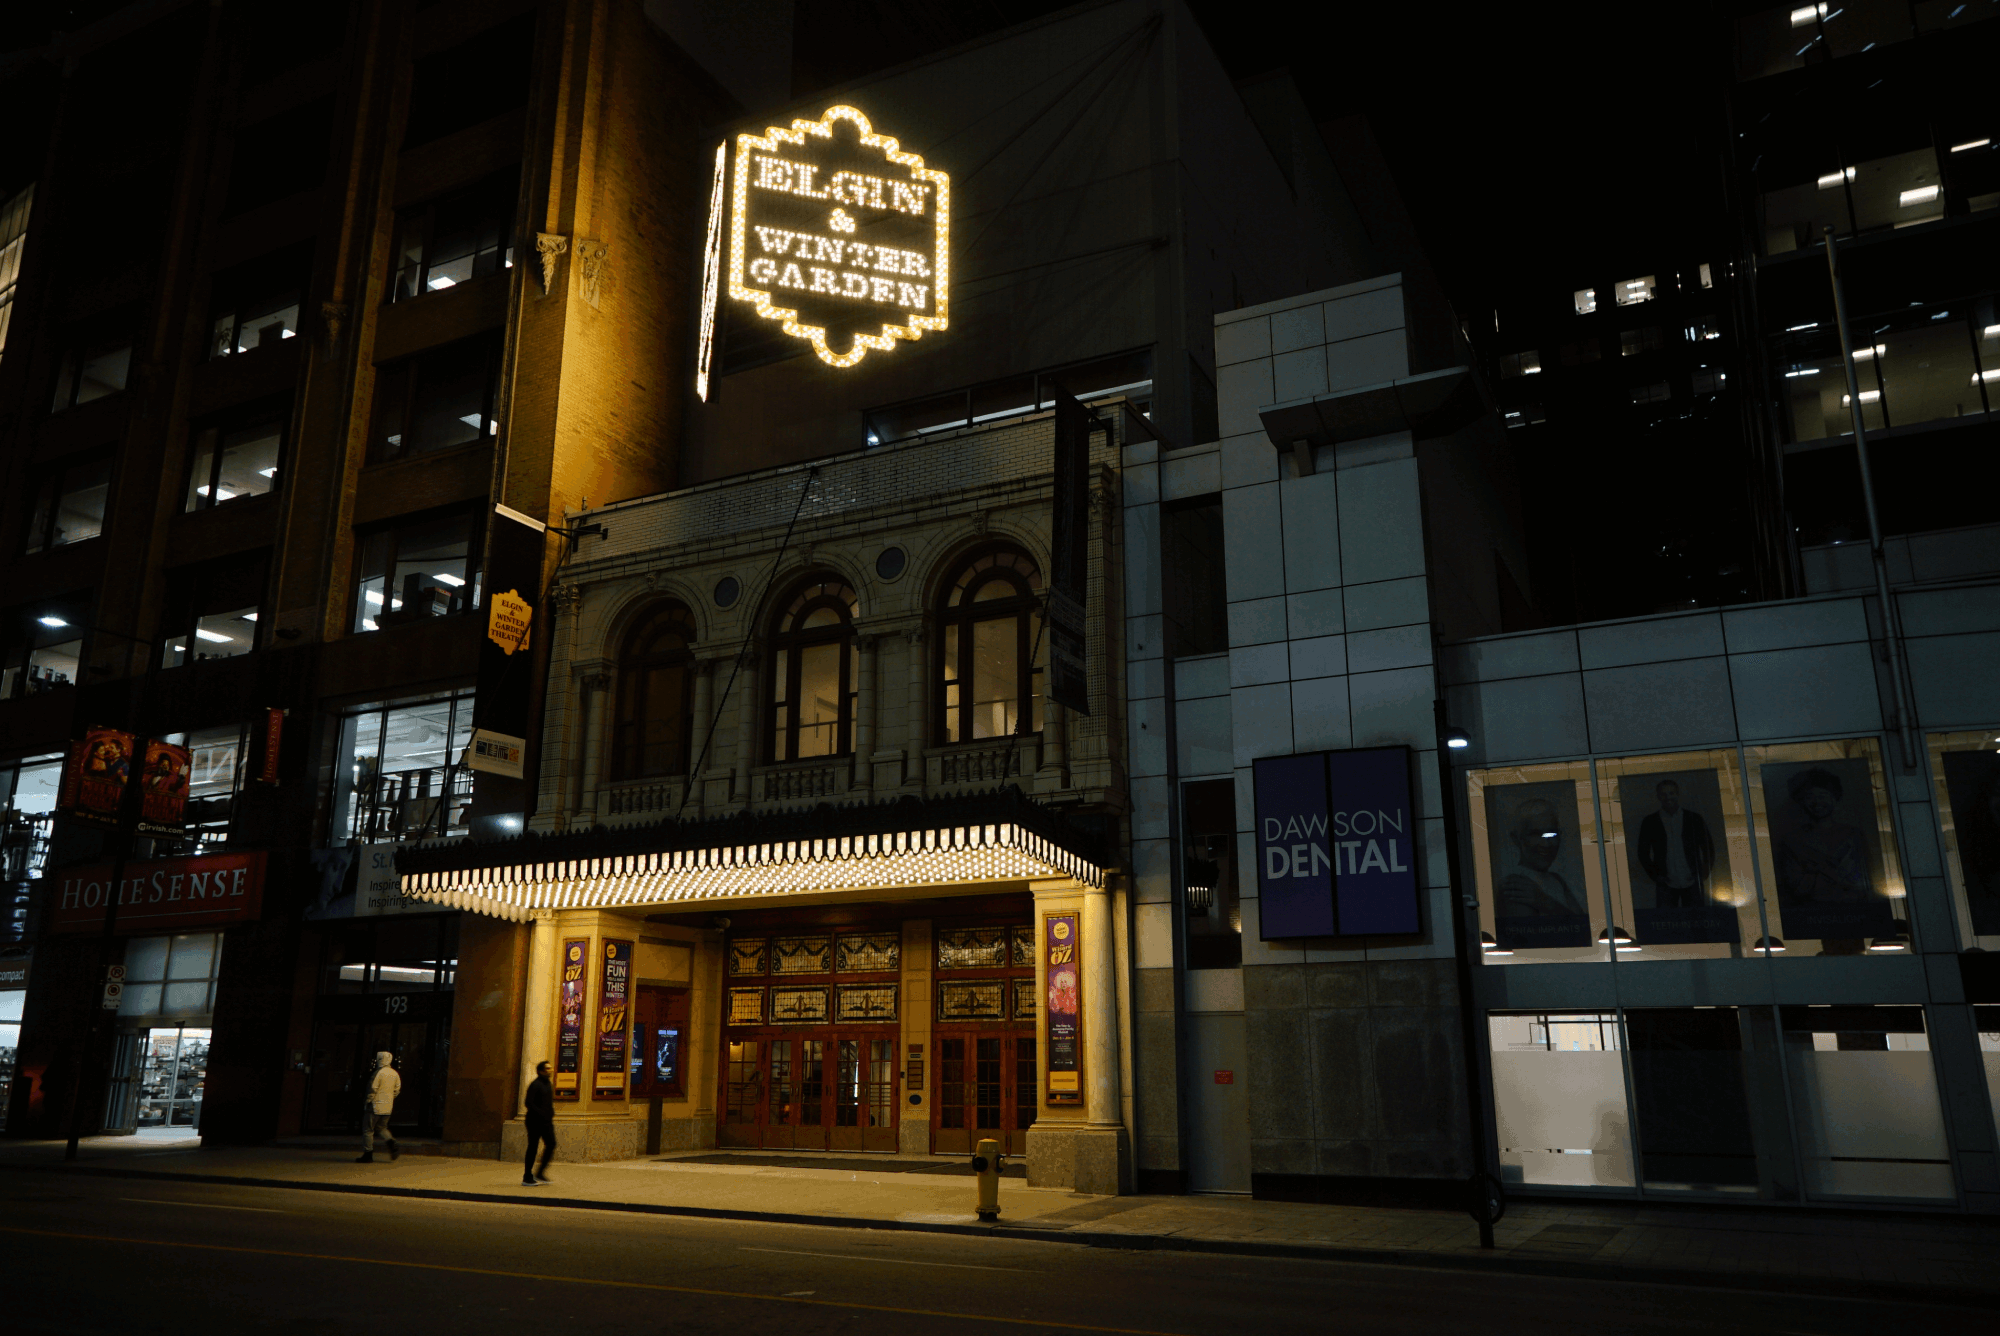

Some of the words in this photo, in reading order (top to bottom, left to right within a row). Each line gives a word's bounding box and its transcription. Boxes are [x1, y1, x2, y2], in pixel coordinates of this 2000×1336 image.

[754, 155, 930, 215] ELGIN
[829, 207, 856, 233] &
[754, 225, 930, 279] WINTER
[749, 258, 930, 309] GARDEN
[502, 600, 523, 612] ELGIN
[497, 613, 525, 628] WINTER
[495, 622, 526, 636] GARDEN
[1265, 808, 1403, 842] DAWSON
[372, 853, 388, 869] St.
[1266, 838, 1408, 880] DENTAL
[370, 879, 400, 894] Inspire
[368, 895, 407, 909] Inspiring
[606, 965, 626, 977] FUN
[607, 981, 625, 993] THIS
[384, 996, 408, 1014] 193
